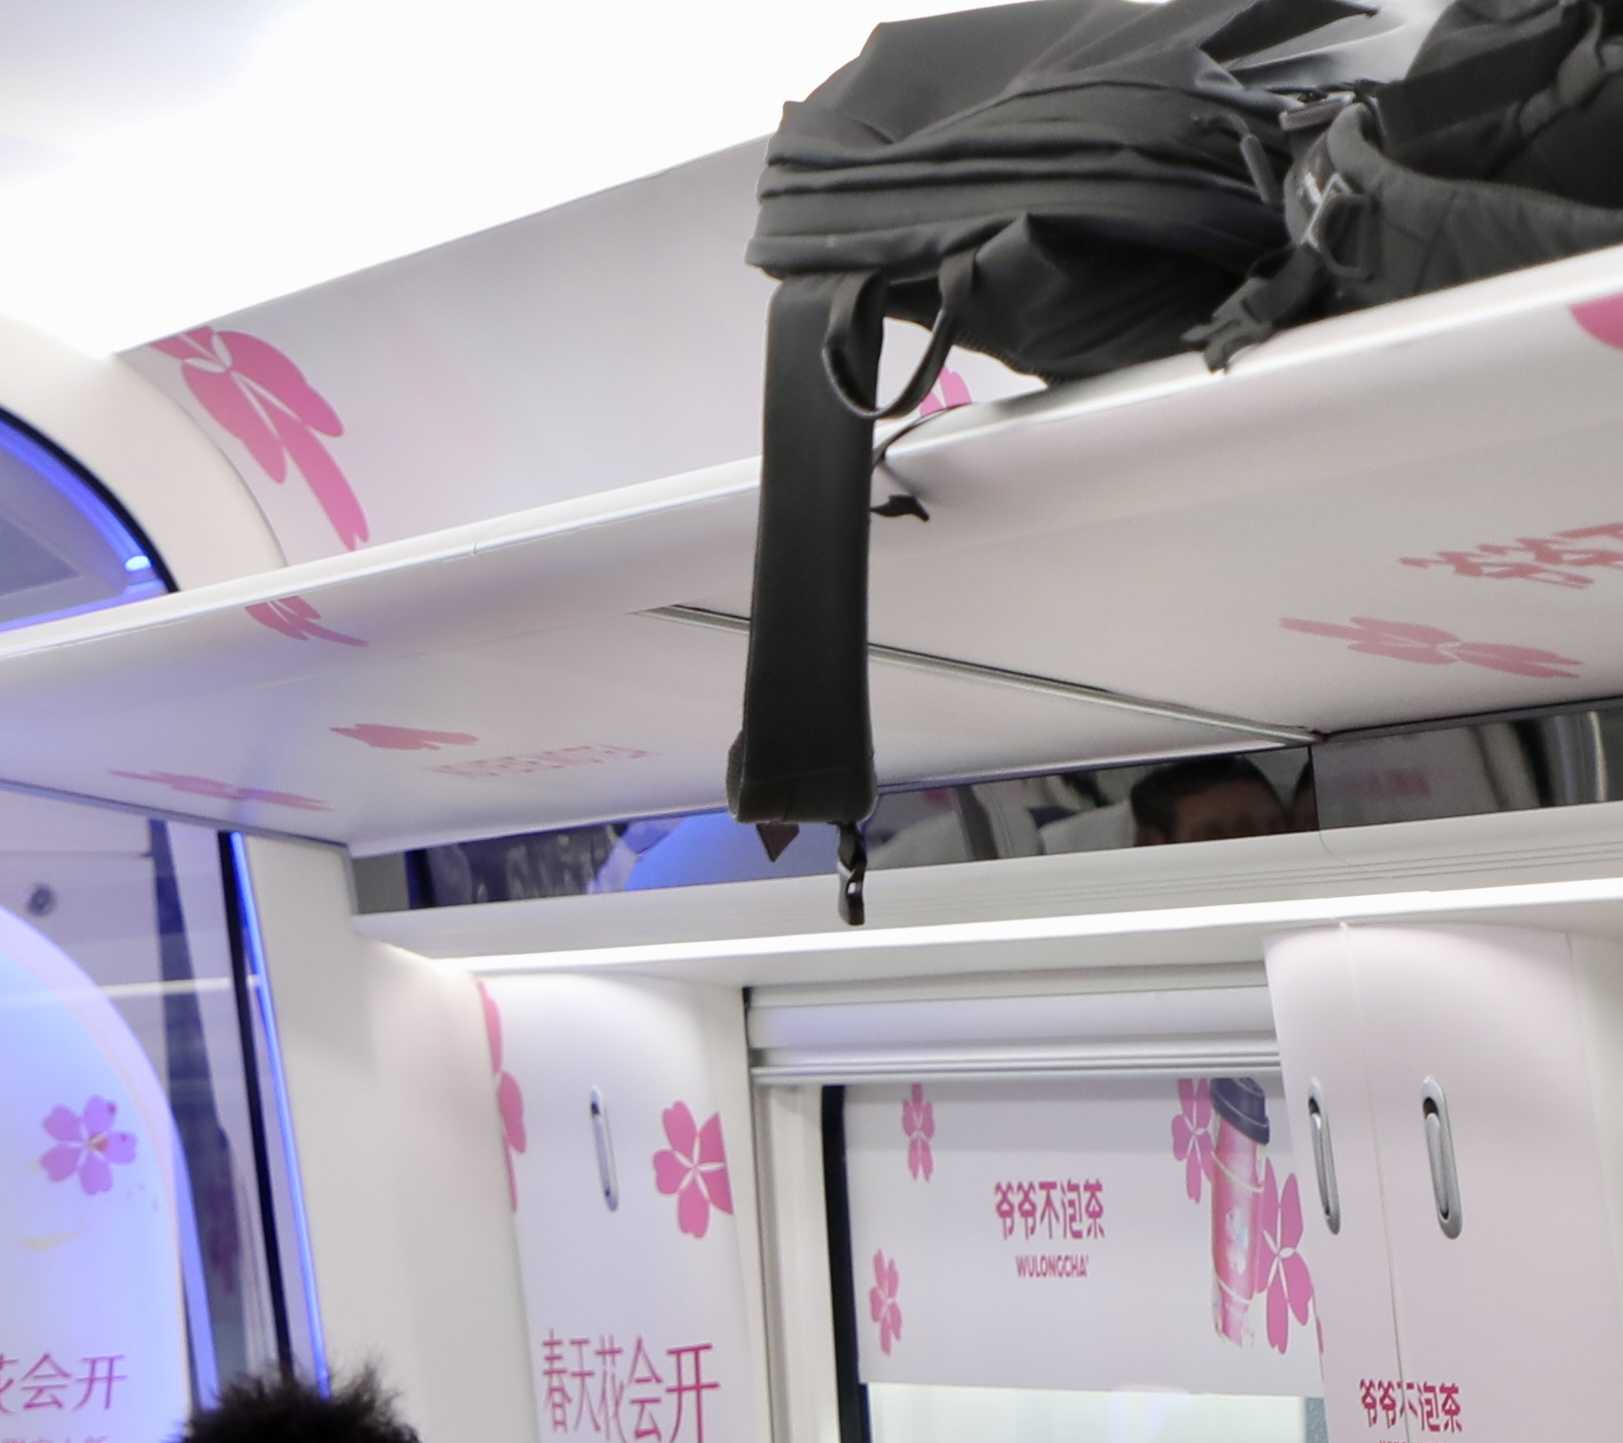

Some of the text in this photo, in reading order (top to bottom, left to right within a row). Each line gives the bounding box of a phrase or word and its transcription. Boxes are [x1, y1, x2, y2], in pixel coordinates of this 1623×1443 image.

[994, 1177, 1105, 1241] 爷爷不泡茶
